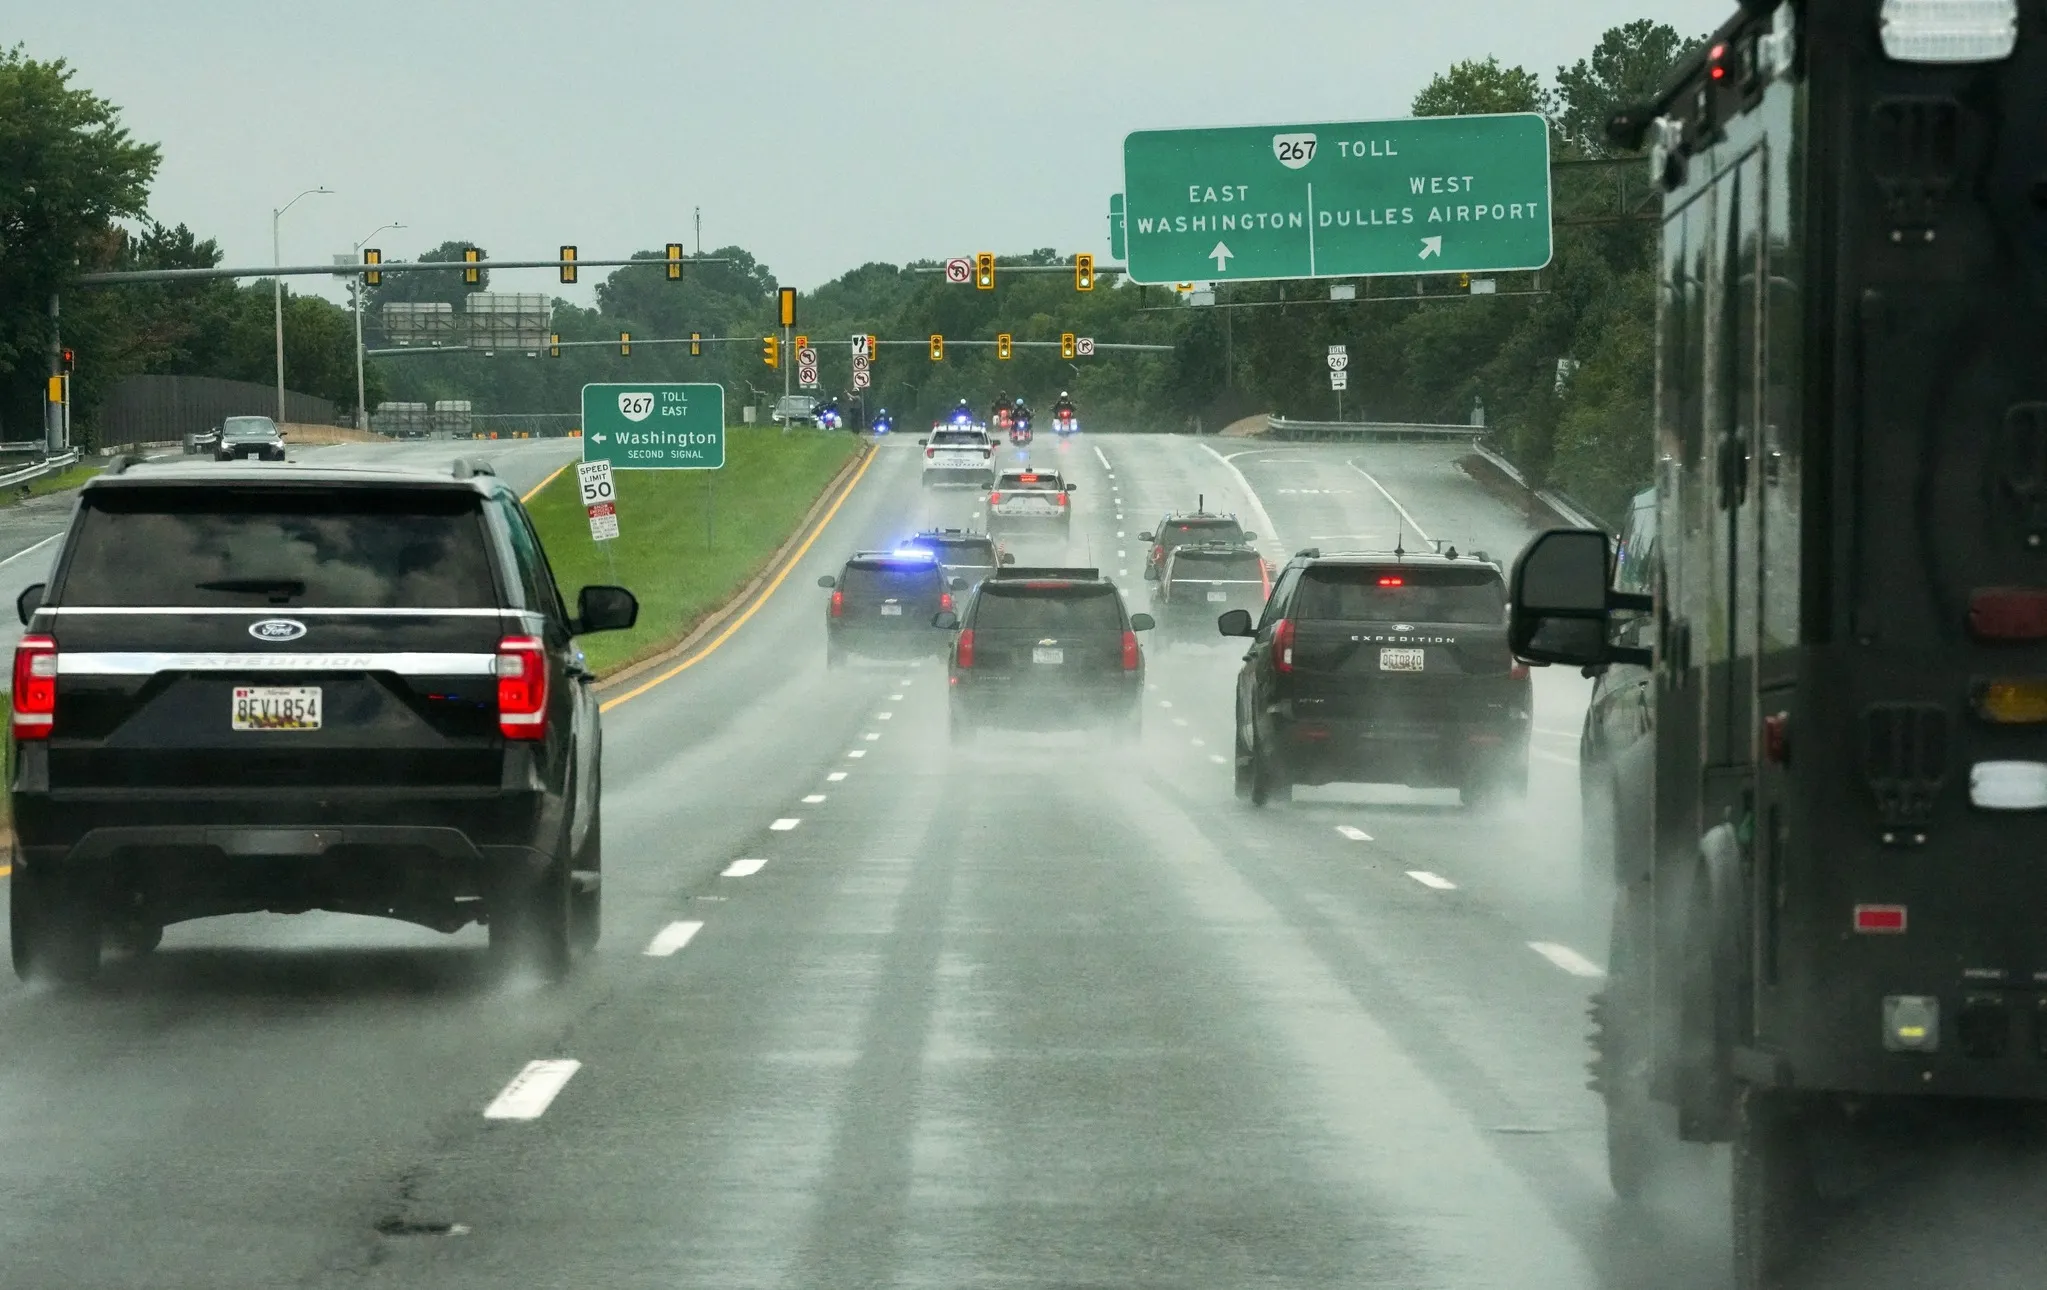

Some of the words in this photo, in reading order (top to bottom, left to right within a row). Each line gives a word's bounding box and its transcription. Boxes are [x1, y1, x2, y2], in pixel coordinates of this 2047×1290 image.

[1278, 140, 1316, 161] 267
[1337, 140, 1398, 158] TOLL
[1188, 184, 1249, 204] EAST
[1408, 175, 1475, 195] WEST
[1137, 212, 1304, 235] WASHINGTON
[1318, 207, 1414, 228] DULLES
[1427, 202, 1539, 223] AIRPORT
[1330, 357, 1347, 367] 267
[622, 397, 652, 414] 267
[661, 391, 688, 402] TOLL
[661, 406, 688, 416] EAST
[615, 430, 717, 448] Washington
[627, 450, 664, 459] SECOND
[670, 450, 704, 459] SIGNAL
[579, 464, 609, 475] SPEED
[584, 473, 607, 483] LIMIT
[584, 482, 612, 500] 50
[261, 623, 293, 636] Ford
[1351, 635, 1455, 644] EXPEDITION
[179, 656, 373, 667] EXPEDITION
[237, 698, 317, 722] 8EV1854
